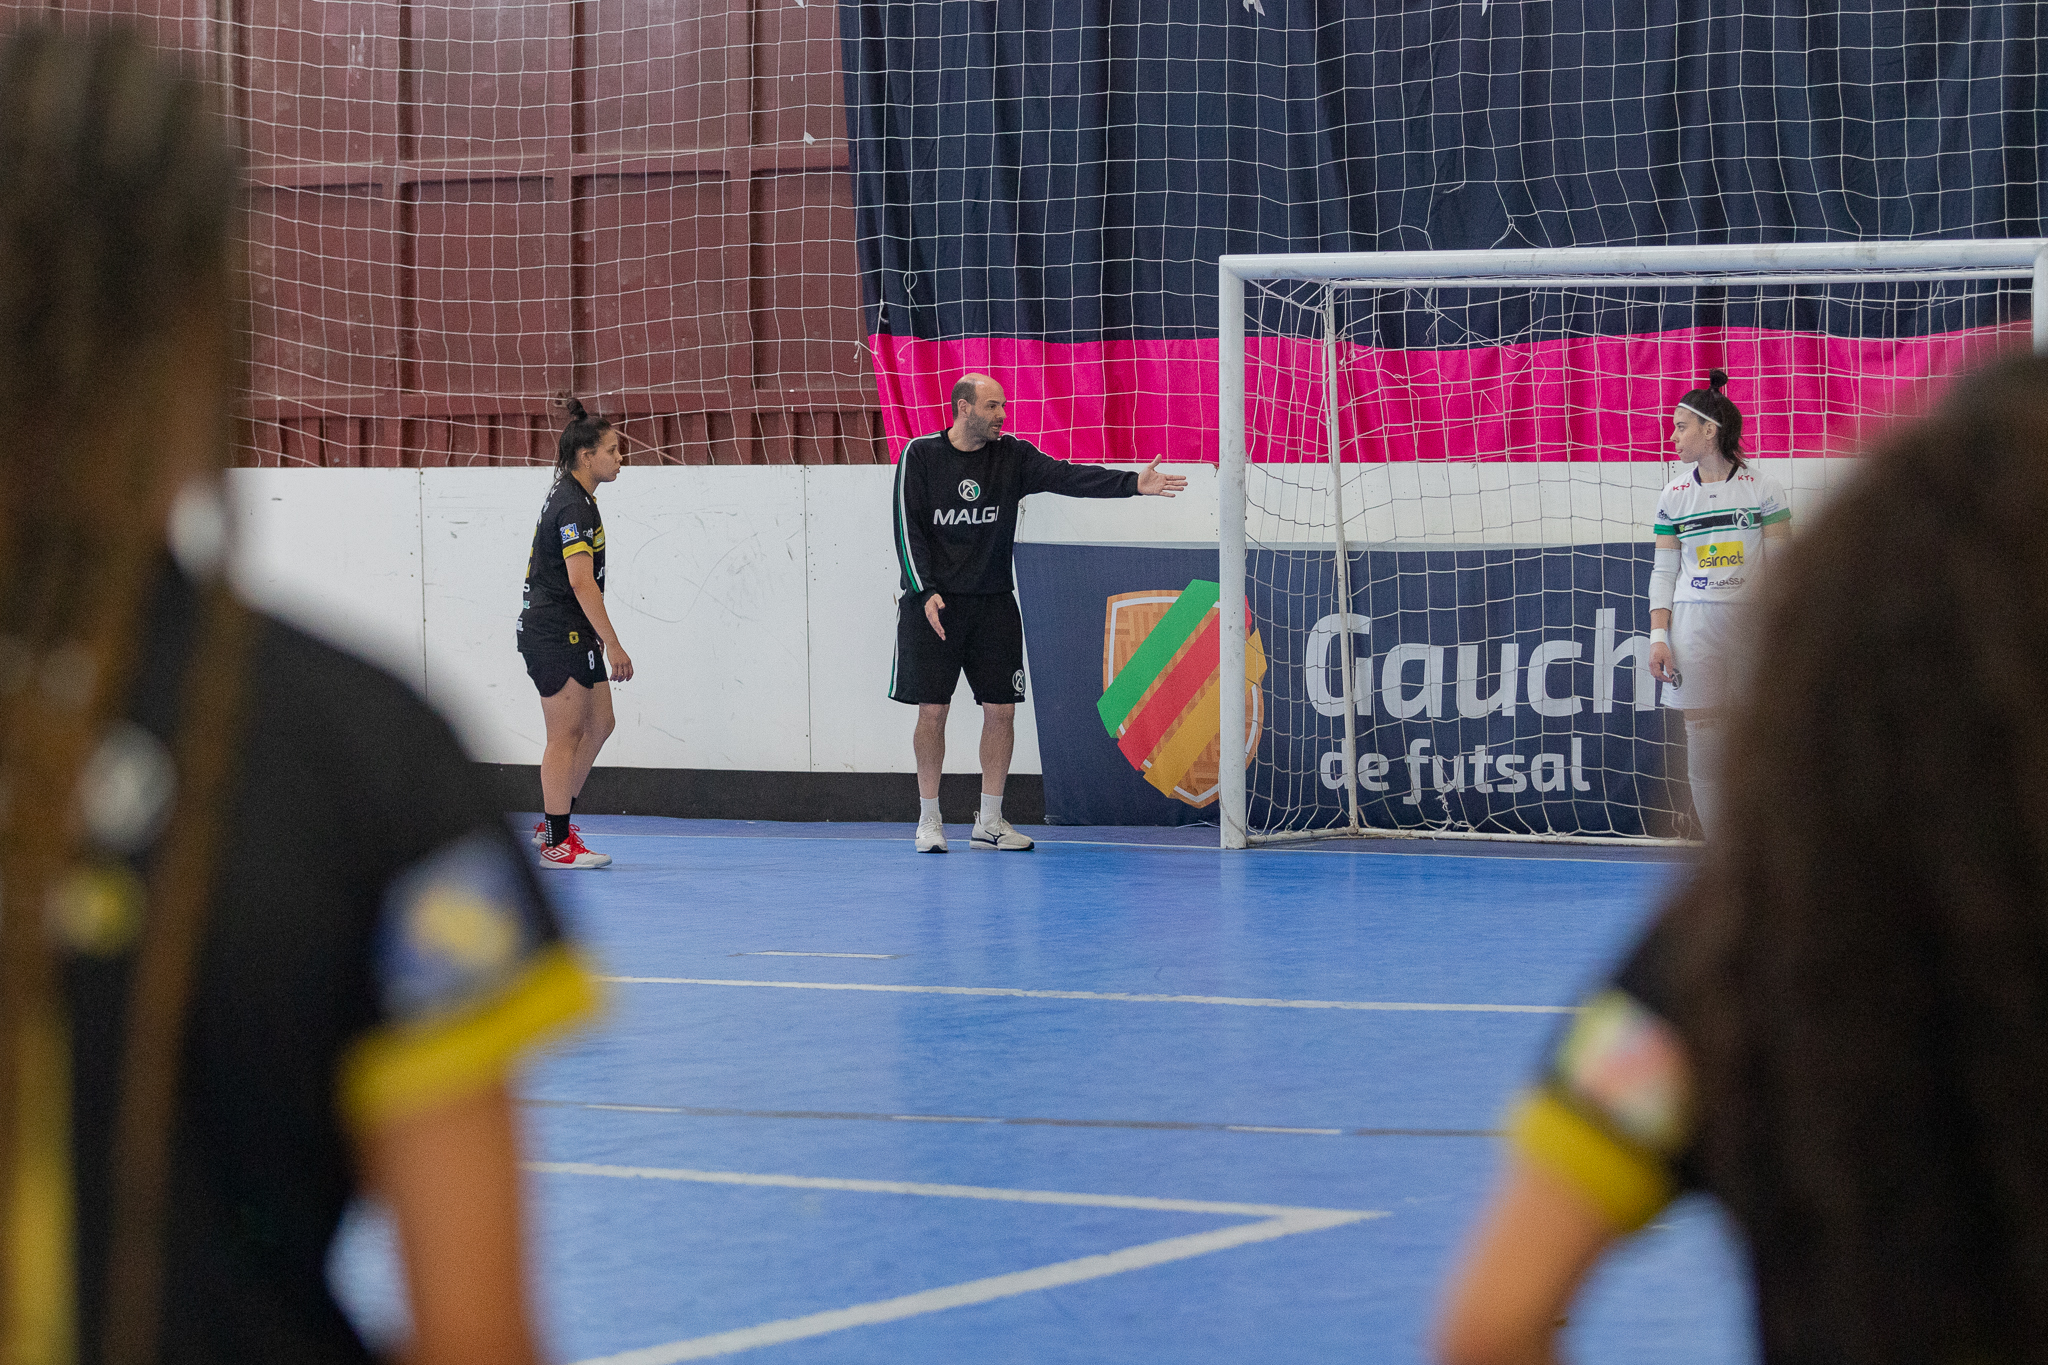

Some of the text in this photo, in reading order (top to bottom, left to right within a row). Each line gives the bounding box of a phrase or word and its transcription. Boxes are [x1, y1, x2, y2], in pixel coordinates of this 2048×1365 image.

[1699, 551, 1744, 568] osirnet
[1305, 608, 1656, 719] Gauch
[1320, 738, 1591, 804] de futsal
